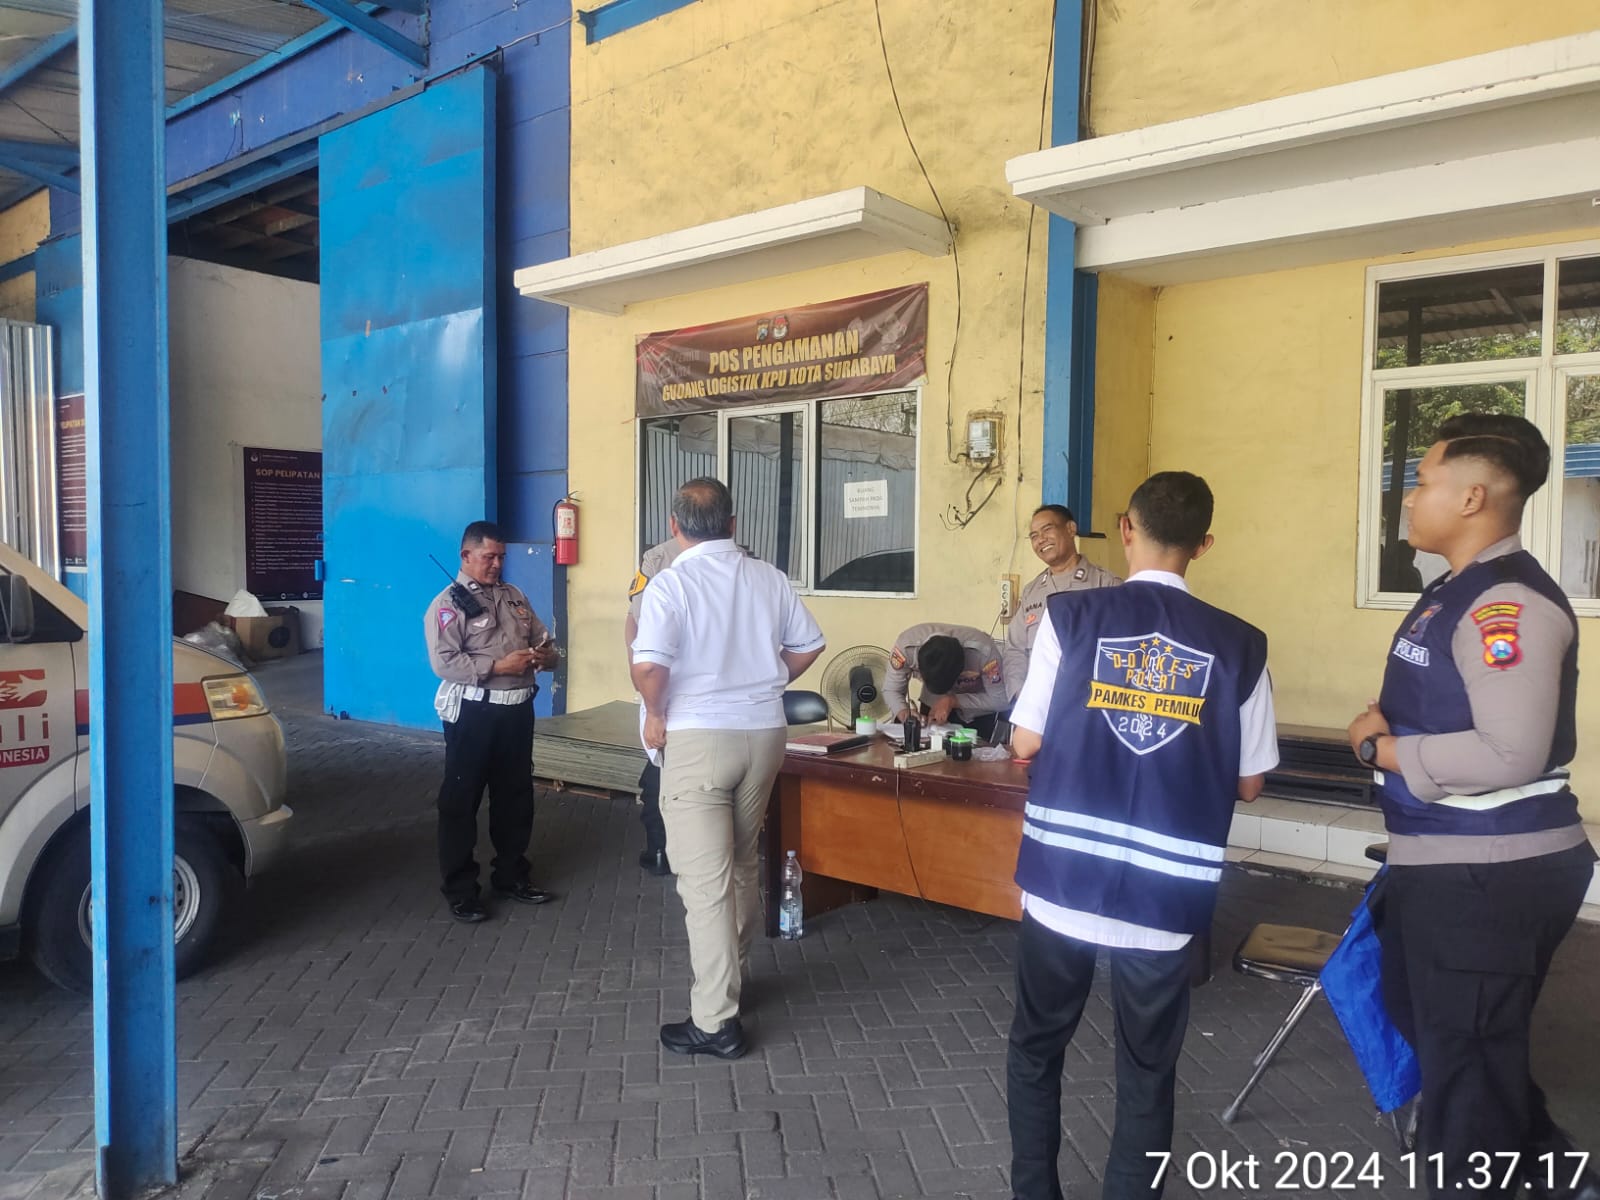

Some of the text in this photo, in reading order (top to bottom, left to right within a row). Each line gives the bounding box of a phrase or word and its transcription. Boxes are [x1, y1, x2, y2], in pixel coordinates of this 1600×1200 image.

[708, 329, 859, 375] POS PENGAMANAN
[662, 354, 896, 401] GUDANG LOGISTIK KPU KOTA SURABAYA
[255, 468, 320, 479] SOP PELIPATAN
[1395, 640, 1425, 663] POLRI
[1113, 652, 1196, 679] DOKKES
[1125, 669, 1177, 690] POLRI
[1094, 688, 1200, 718] PAMKES PEMILU
[1118, 716, 1167, 739] 2024
[0, 747, 45, 763] NESIA
